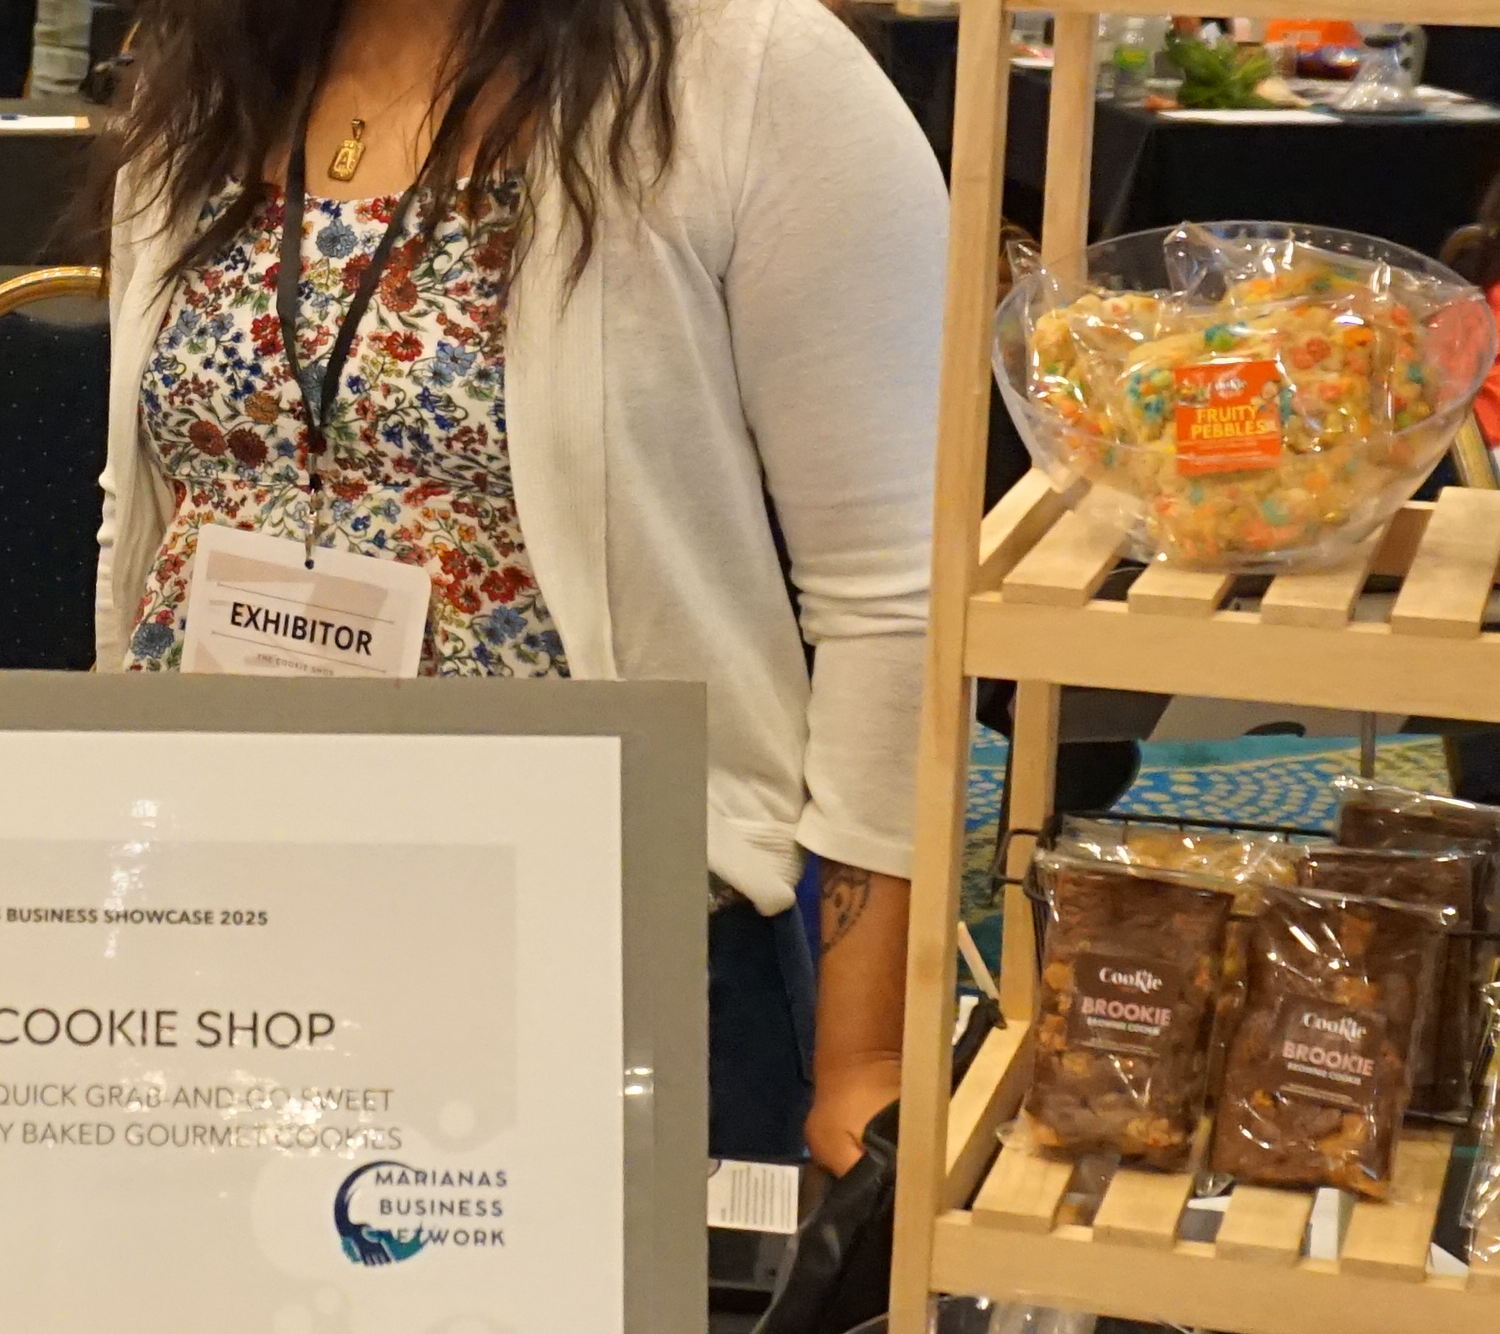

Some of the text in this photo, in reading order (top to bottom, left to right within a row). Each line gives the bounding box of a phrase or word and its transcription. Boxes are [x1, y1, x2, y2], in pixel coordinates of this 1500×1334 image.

[1196, 404, 1258, 424] FRUITY
[1190, 419, 1266, 440] PEBBLES
[230, 601, 374, 657] EXHIBITOR
[5, 906, 99, 925] BUSINESS
[103, 908, 215, 927] SHOWCASE
[219, 909, 269, 927] 2025
[1098, 967, 1164, 994] Cookie
[1080, 996, 1173, 1028] BROOKIE
[195, 1009, 336, 1051] SHOP
[1301, 1011, 1368, 1043] Cookie
[1281, 1040, 1375, 1078] BROOKIE
[20, 1121, 115, 1146] BAKED
[125, 1121, 268, 1148] GOURMET
[374, 1169, 510, 1189] MARIANAS
[379, 1198, 504, 1218] BUSINESS
